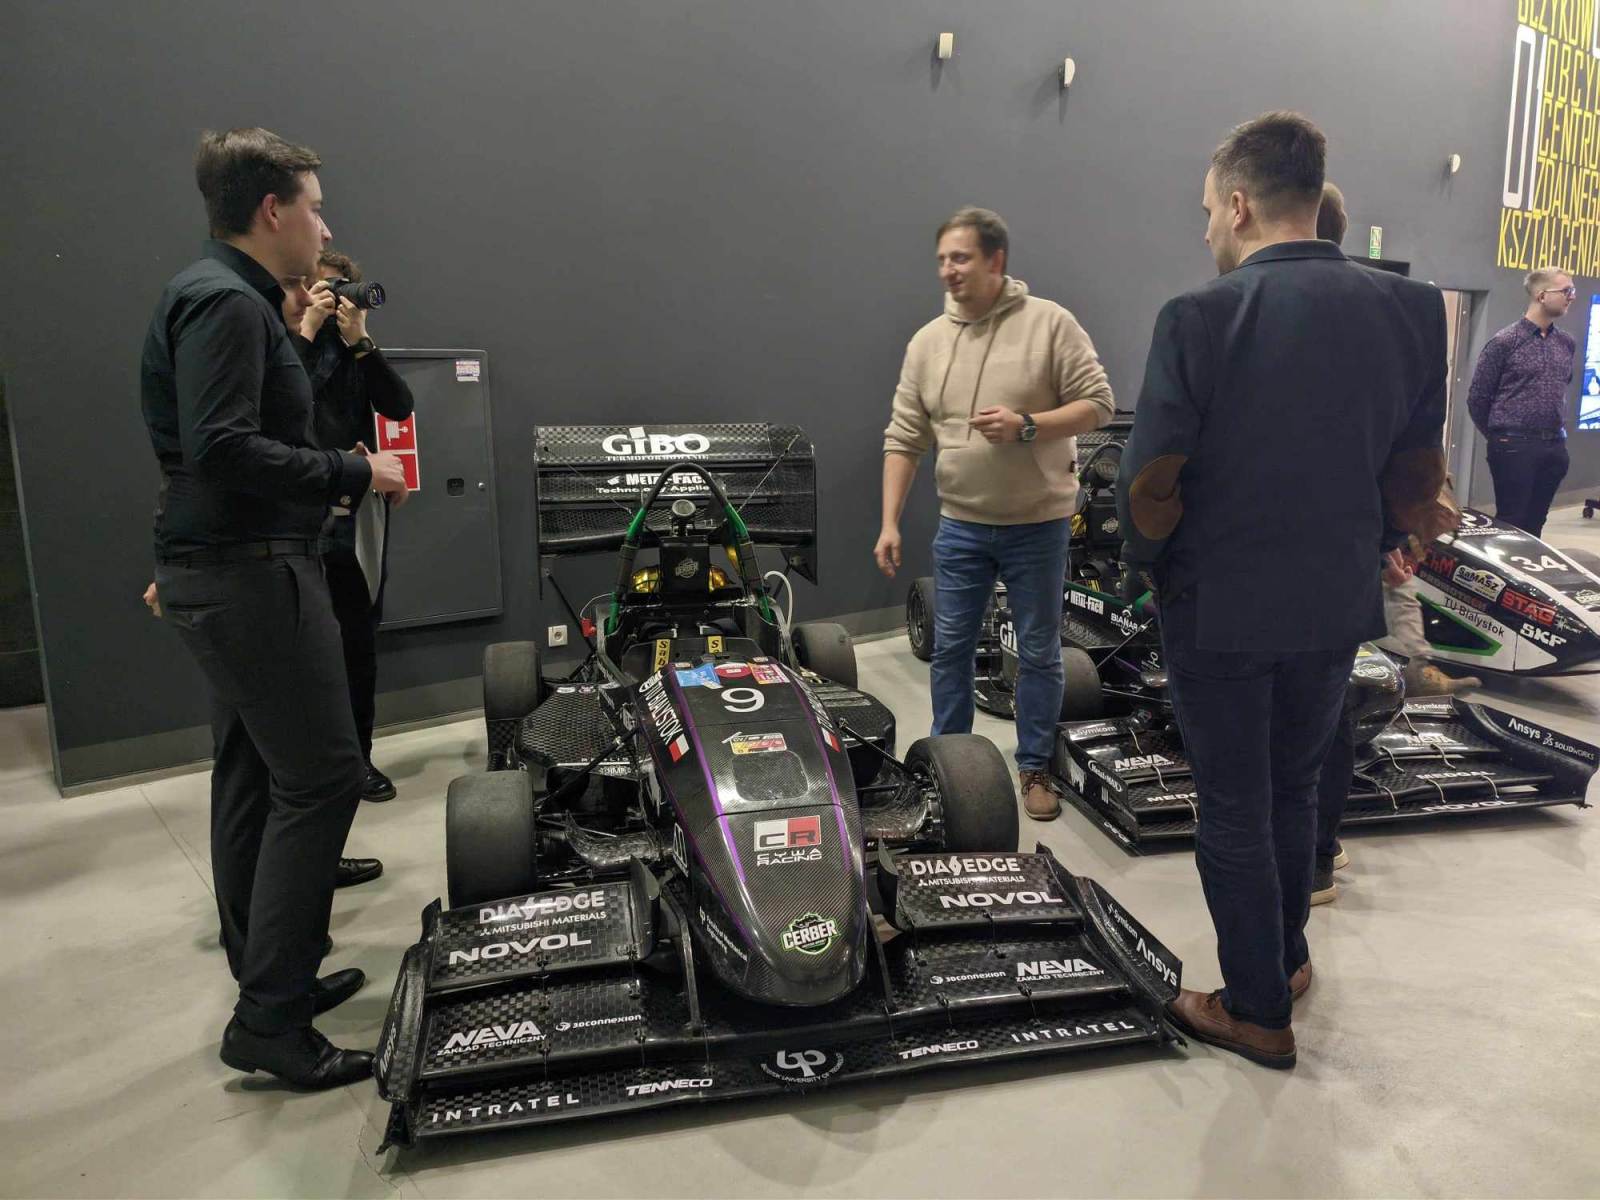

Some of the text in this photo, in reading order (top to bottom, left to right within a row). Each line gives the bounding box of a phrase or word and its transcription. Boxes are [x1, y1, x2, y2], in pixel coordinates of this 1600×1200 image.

[1541, 37, 1600, 117] OBCY
[1531, 155, 1600, 226] ZDALNEG
[1510, 555, 1569, 572] 34
[1503, 591, 1556, 624] STAG
[1520, 622, 1567, 647] SKF
[721, 687, 765, 713] 9
[1508, 718, 1541, 739] Ansys
[1114, 754, 1170, 769] NEVA
[940, 892, 1063, 908] NOVOL
[492, 911, 607, 935] MITSUBISHI MATERIALS
[783, 920, 837, 949] CERBER
[449, 932, 591, 965] NOVOL
[1017, 959, 1098, 977] NEVA
[1136, 938, 1178, 987] Ansys
[444, 1020, 542, 1050] NEVA
[482, 1034, 547, 1049] TECHNICZNY
[1011, 1020, 1135, 1043] INTRATEL
[899, 1040, 979, 1060] TENNECO
[626, 1078, 713, 1097] TENNECO
[432, 1093, 580, 1123] INTRATEL
